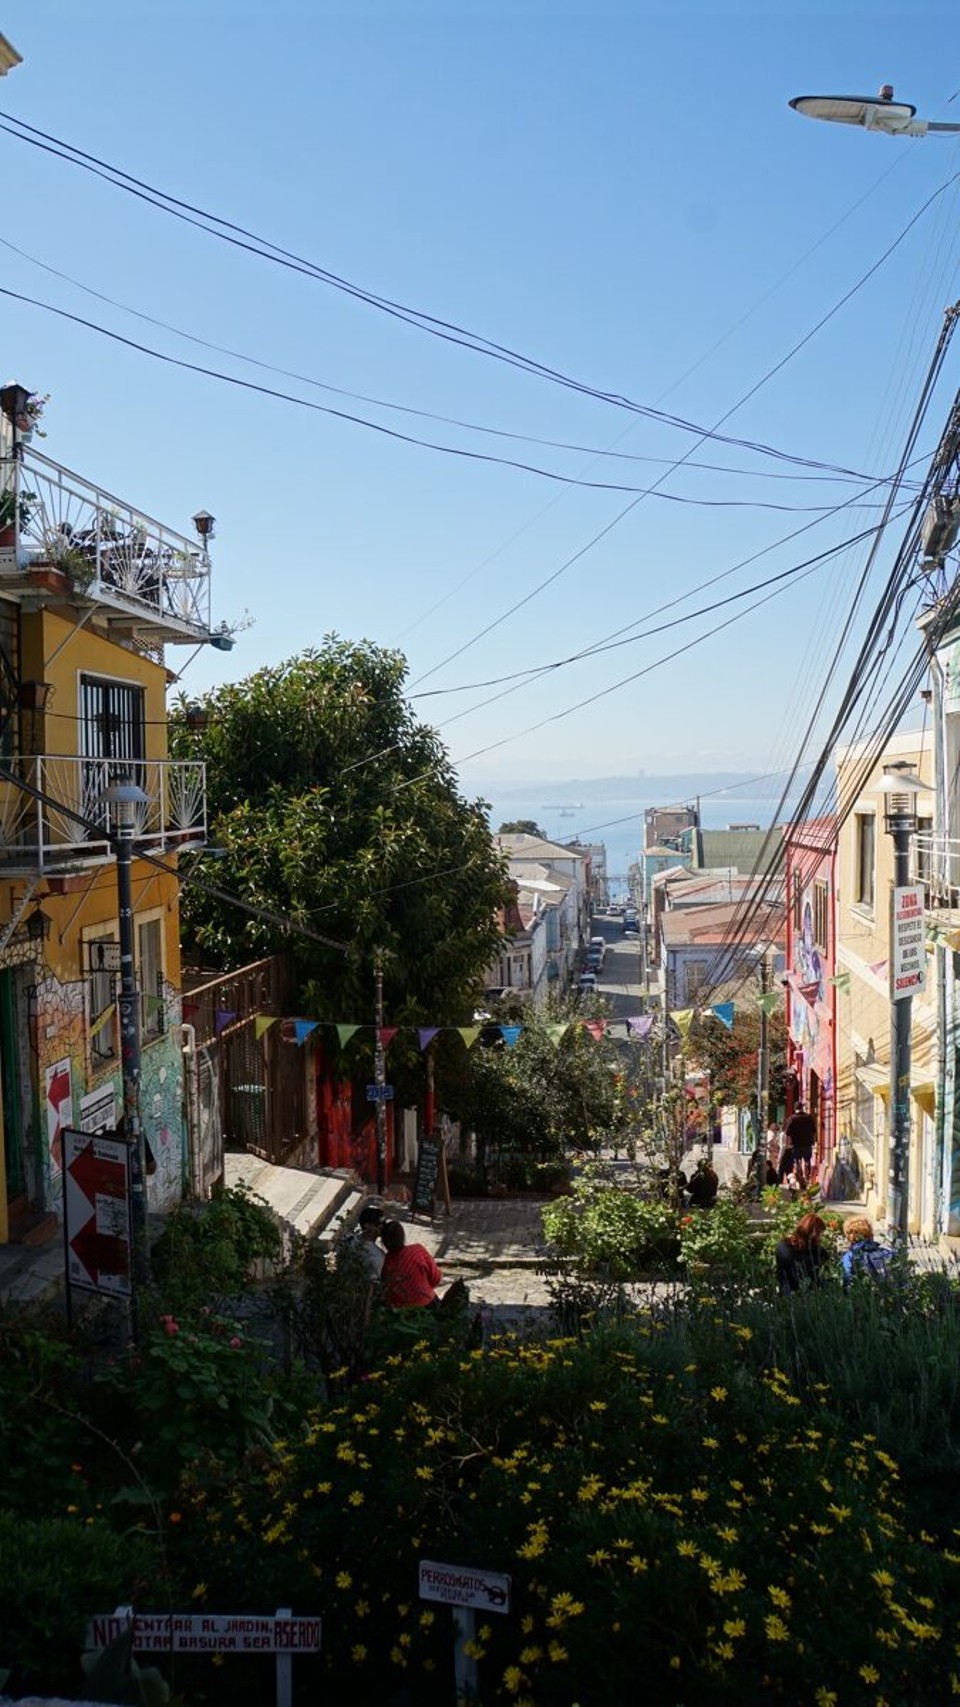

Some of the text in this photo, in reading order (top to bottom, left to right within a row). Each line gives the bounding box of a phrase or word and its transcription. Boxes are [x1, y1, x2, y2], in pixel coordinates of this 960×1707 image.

[902, 893, 917, 908] ZONA
[898, 921, 916, 933] RESPETE
[421, 1568, 456, 1588] PERROS
[202, 1620, 219, 1632] AL
[93, 1619, 121, 1647] NO
[179, 1637, 236, 1648] BASURA
